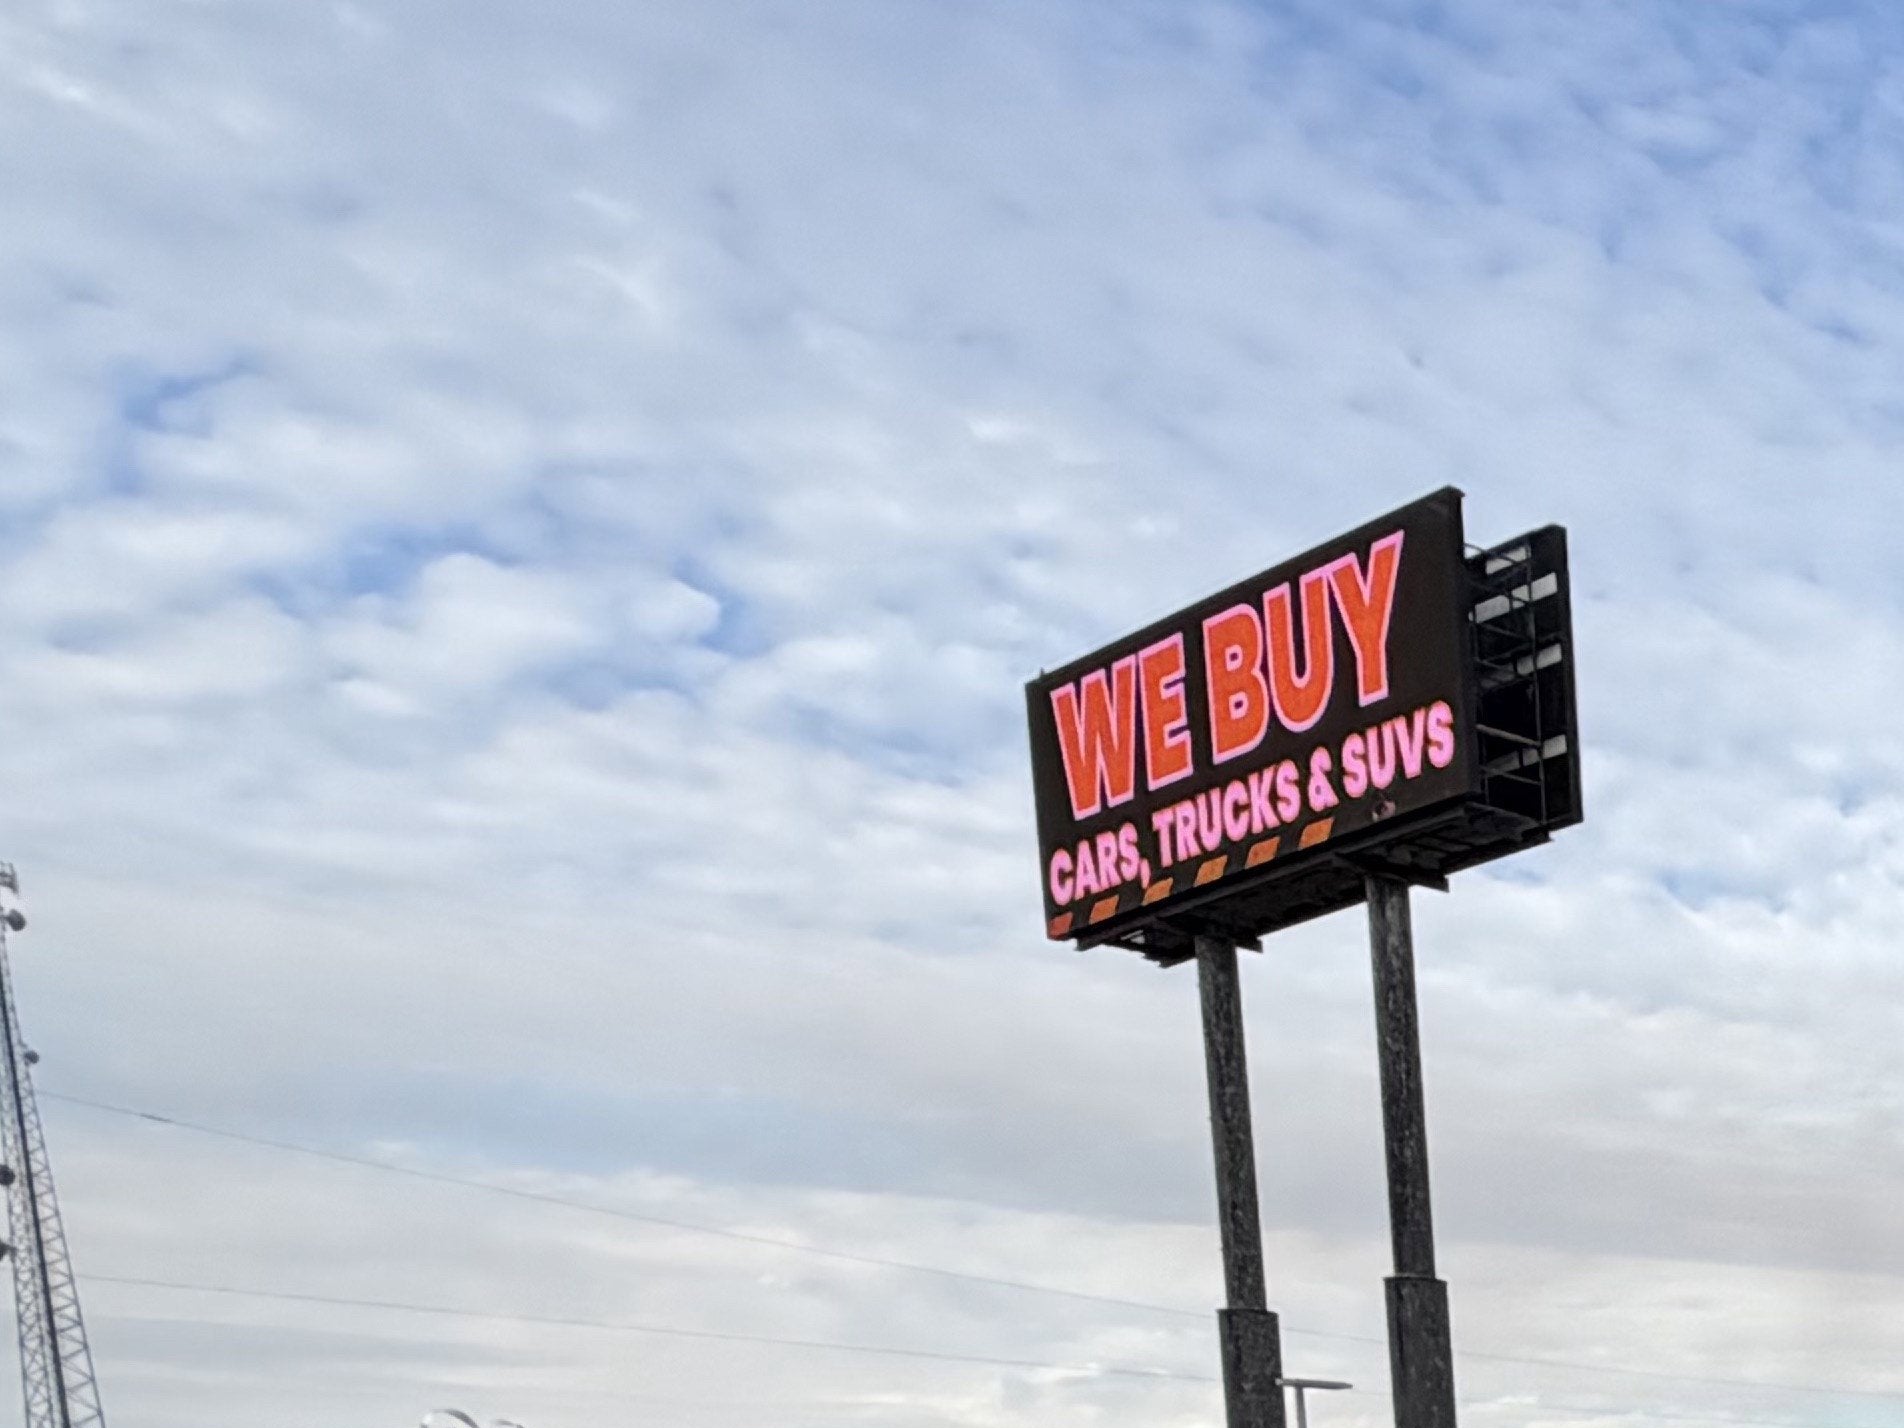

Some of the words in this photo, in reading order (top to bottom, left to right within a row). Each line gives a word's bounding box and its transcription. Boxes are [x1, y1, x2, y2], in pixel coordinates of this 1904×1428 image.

[1050, 632, 1194, 821] WE
[1202, 529, 1404, 765] BUY
[1049, 822, 1152, 906] CARS,
[1152, 758, 1301, 868] TRUCKS
[1307, 746, 1341, 812] &
[1341, 700, 1456, 798] SUVS
